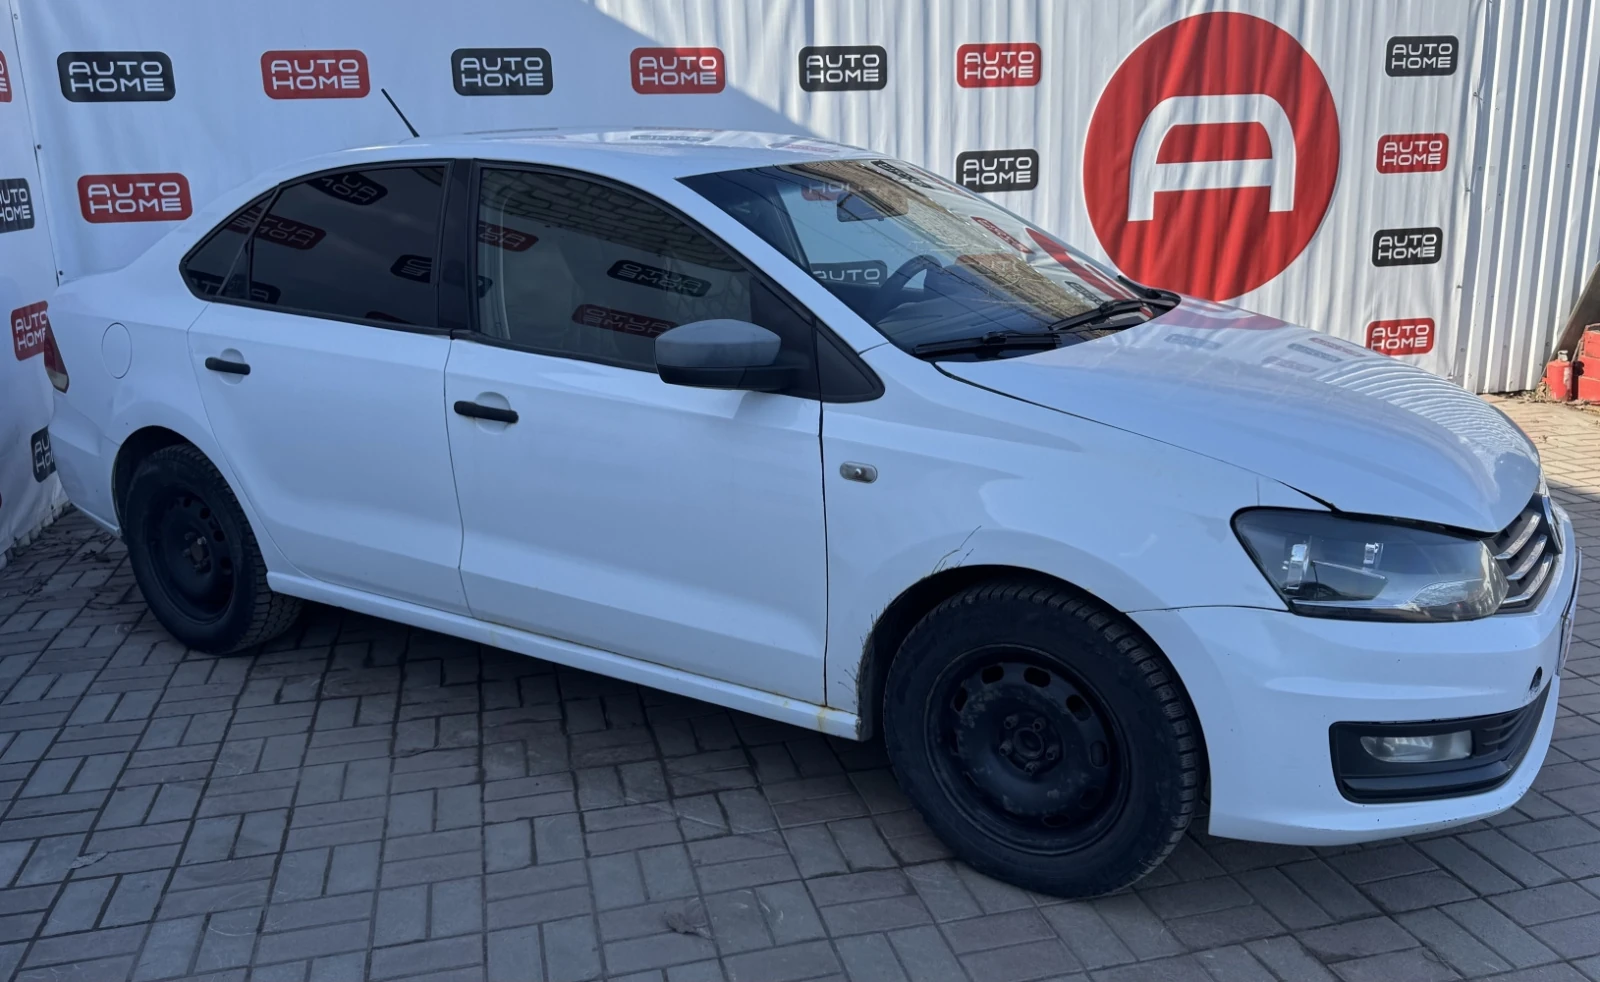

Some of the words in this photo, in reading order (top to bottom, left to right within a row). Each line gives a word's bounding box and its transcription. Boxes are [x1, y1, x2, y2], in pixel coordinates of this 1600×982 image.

[1392, 42, 1453, 57] AUTO
[460, 57, 544, 71] AUTO
[638, 56, 717, 70] AUTO
[806, 54, 880, 68] AUTO
[964, 51, 1035, 65] AUTO
[1391, 55, 1451, 70] HOME
[68, 61, 163, 76] AUTO
[270, 59, 359, 74] AUTO
[963, 65, 1034, 80] HOME
[272, 75, 361, 90] HOME
[461, 72, 544, 87] HOME
[639, 71, 717, 86] HOME
[805, 69, 879, 84] HOME
[70, 77, 165, 93] HOME
[1383, 139, 1444, 155] AUTO
[963, 156, 1033, 171] AUTO
[1382, 152, 1442, 167] HOME
[963, 170, 1032, 186] HOME
[87, 182, 181, 198] AUTO
[89, 198, 183, 215] HOME
[1378, 233, 1438, 248] AUTO
[1377, 245, 1436, 261] HOME
[15, 311, 47, 334] AUTO
[1371, 324, 1430, 338] AUTO
[1370, 335, 1428, 351] HOME
[34, 433, 50, 457] AU
[35, 451, 54, 474] HO
